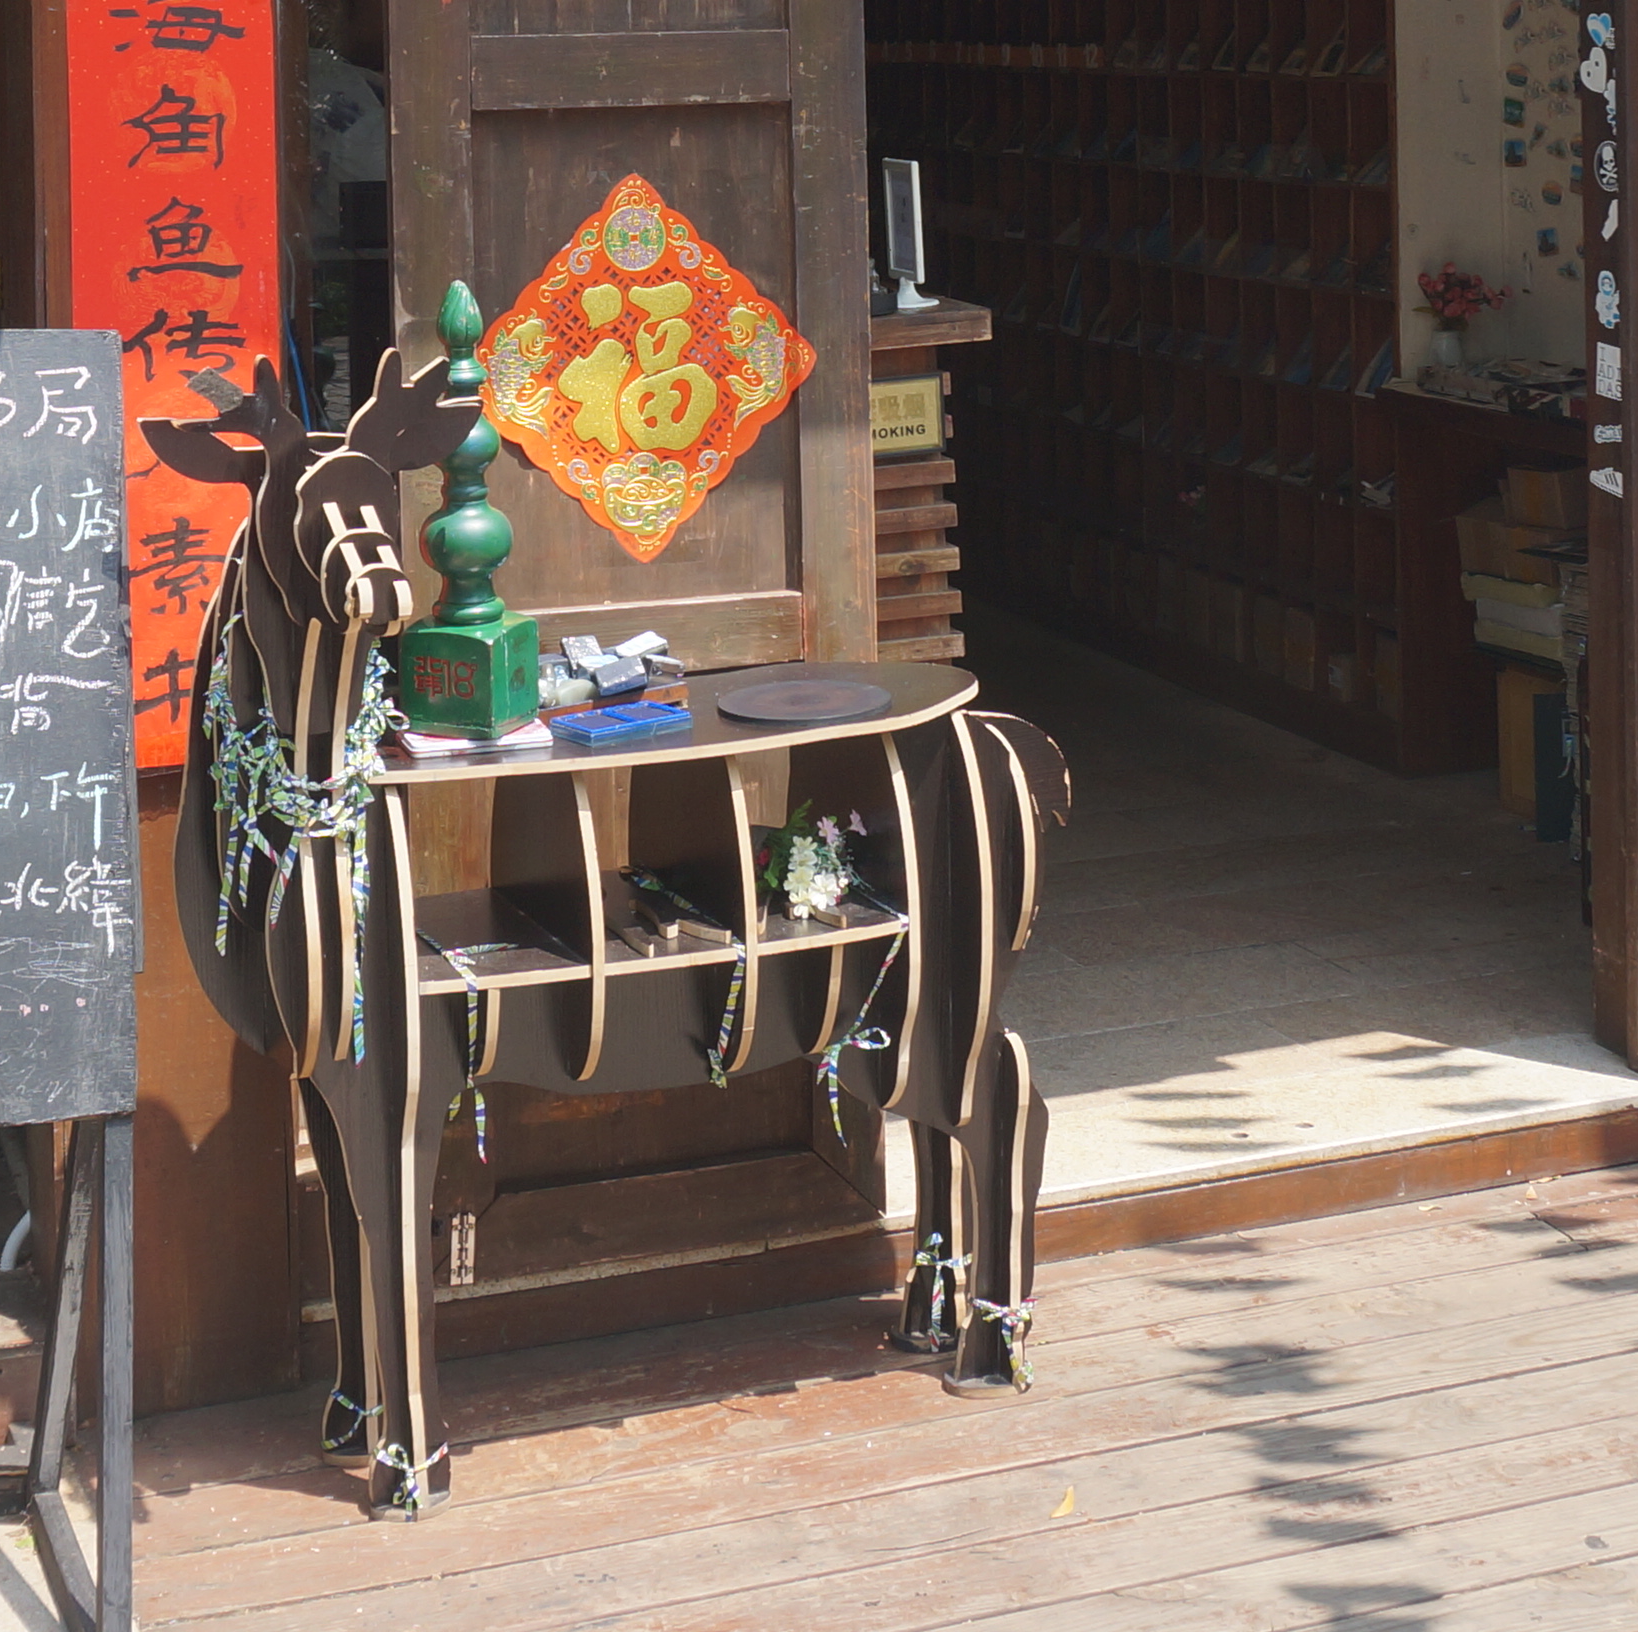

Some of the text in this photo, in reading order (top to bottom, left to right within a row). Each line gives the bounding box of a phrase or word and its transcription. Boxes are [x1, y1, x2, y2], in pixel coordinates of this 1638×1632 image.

[1030, 41, 1043, 67] 10
[1083, 43, 1098, 69] 12
[558, 281, 719, 454] 福
